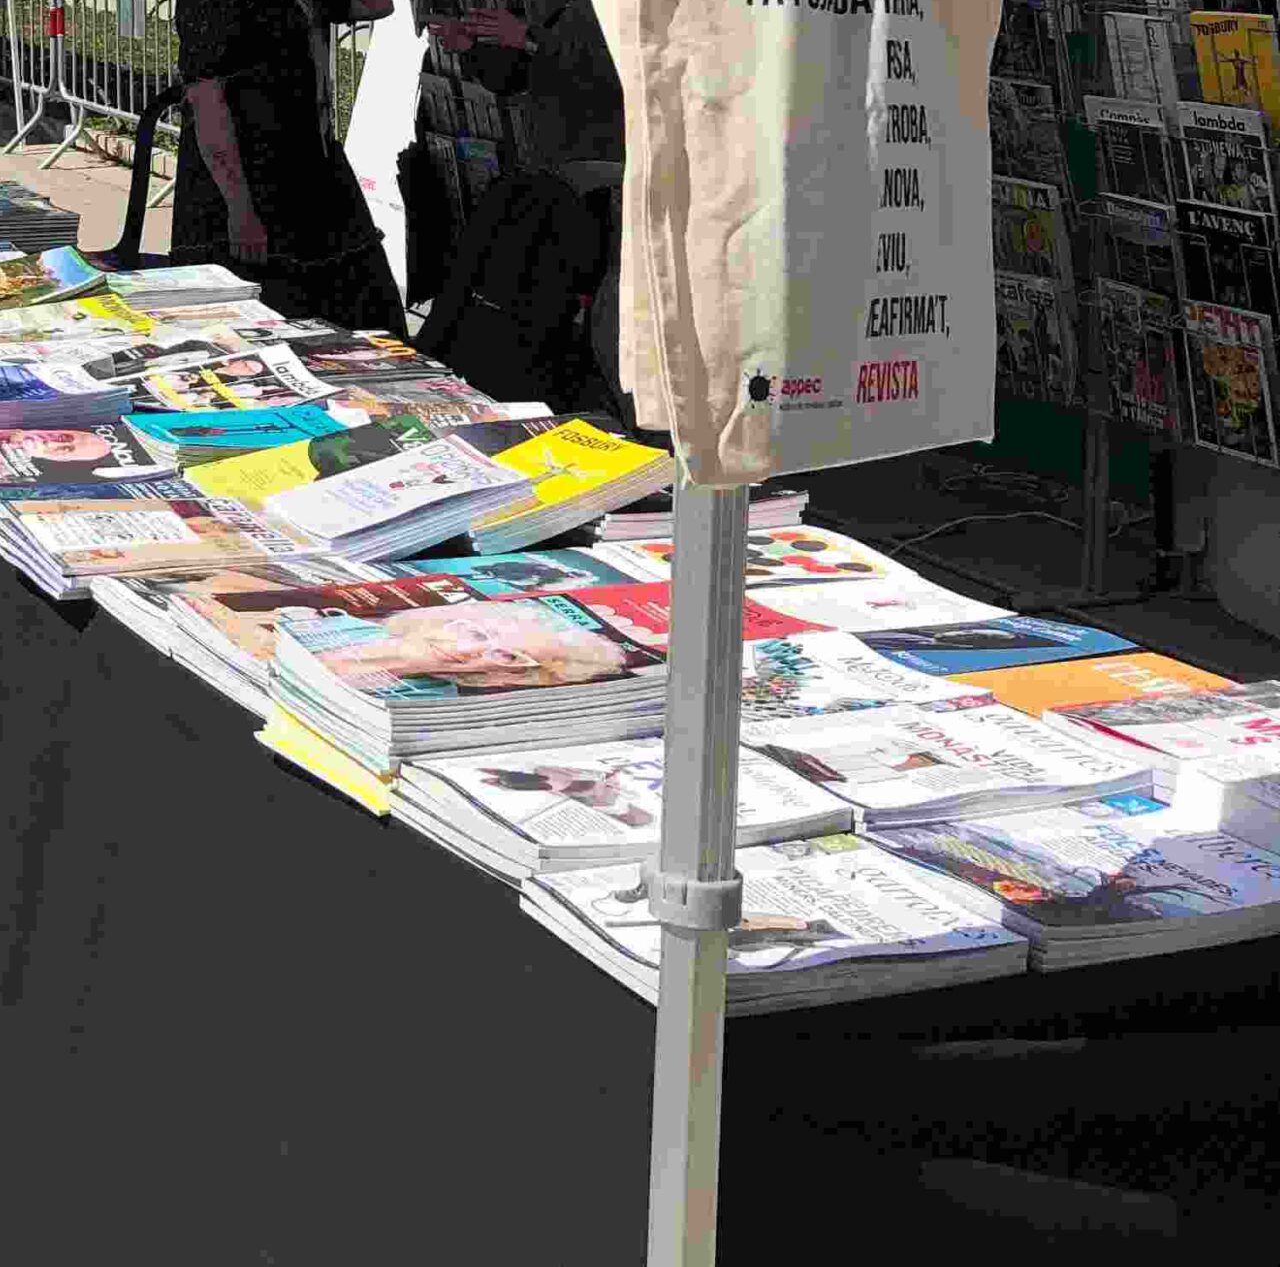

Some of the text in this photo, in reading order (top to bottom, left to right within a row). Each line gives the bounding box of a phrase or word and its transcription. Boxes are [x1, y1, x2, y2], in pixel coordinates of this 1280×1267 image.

[1193, 111, 1246, 131] lambda
[1189, 210, 1256, 244] L'AVENÇ
[856, 360, 919, 404] REVISTA
[551, 427, 627, 453] FOSBURY
[546, 594, 600, 630] SERRA
